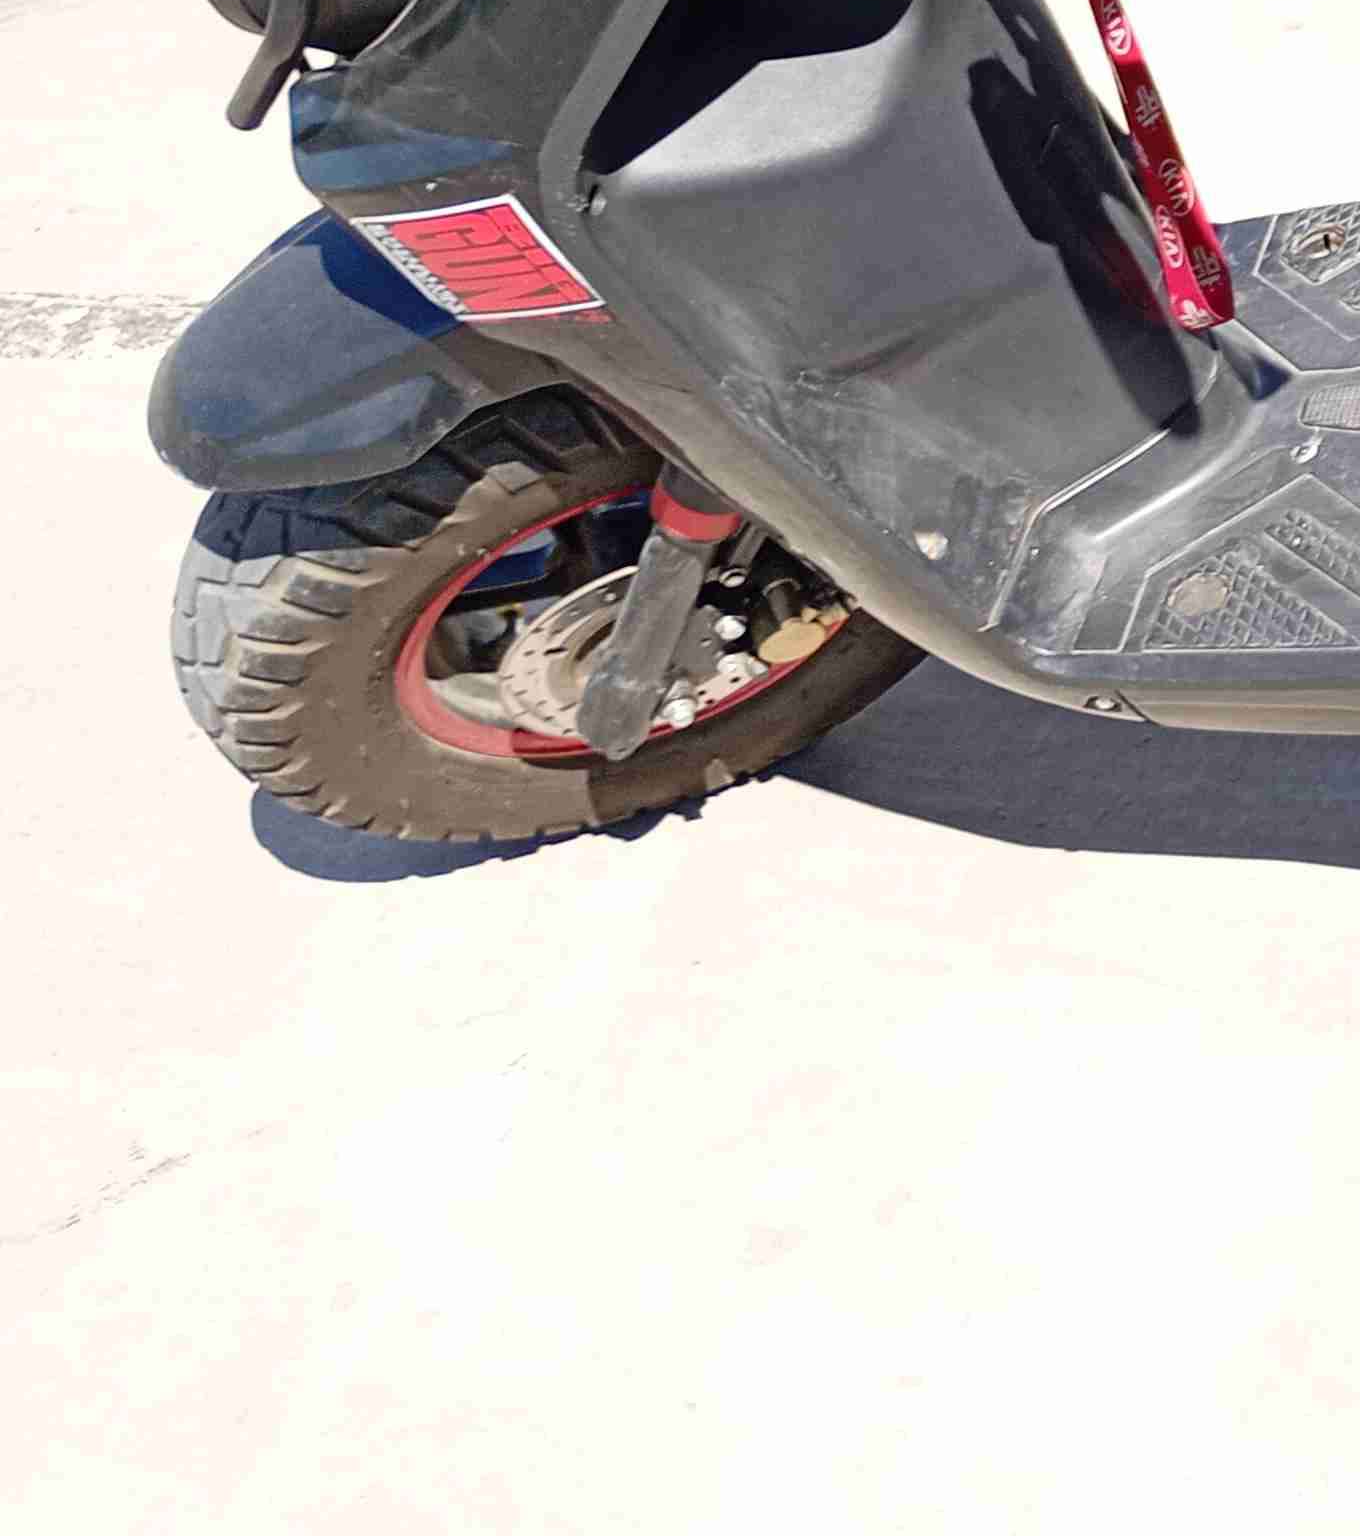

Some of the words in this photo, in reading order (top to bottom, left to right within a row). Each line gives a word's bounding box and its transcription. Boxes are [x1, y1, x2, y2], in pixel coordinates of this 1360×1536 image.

[1160, 162, 1194, 214] KIA
[390, 212, 568, 313] GUN
[1157, 208, 1183, 264] KIA
